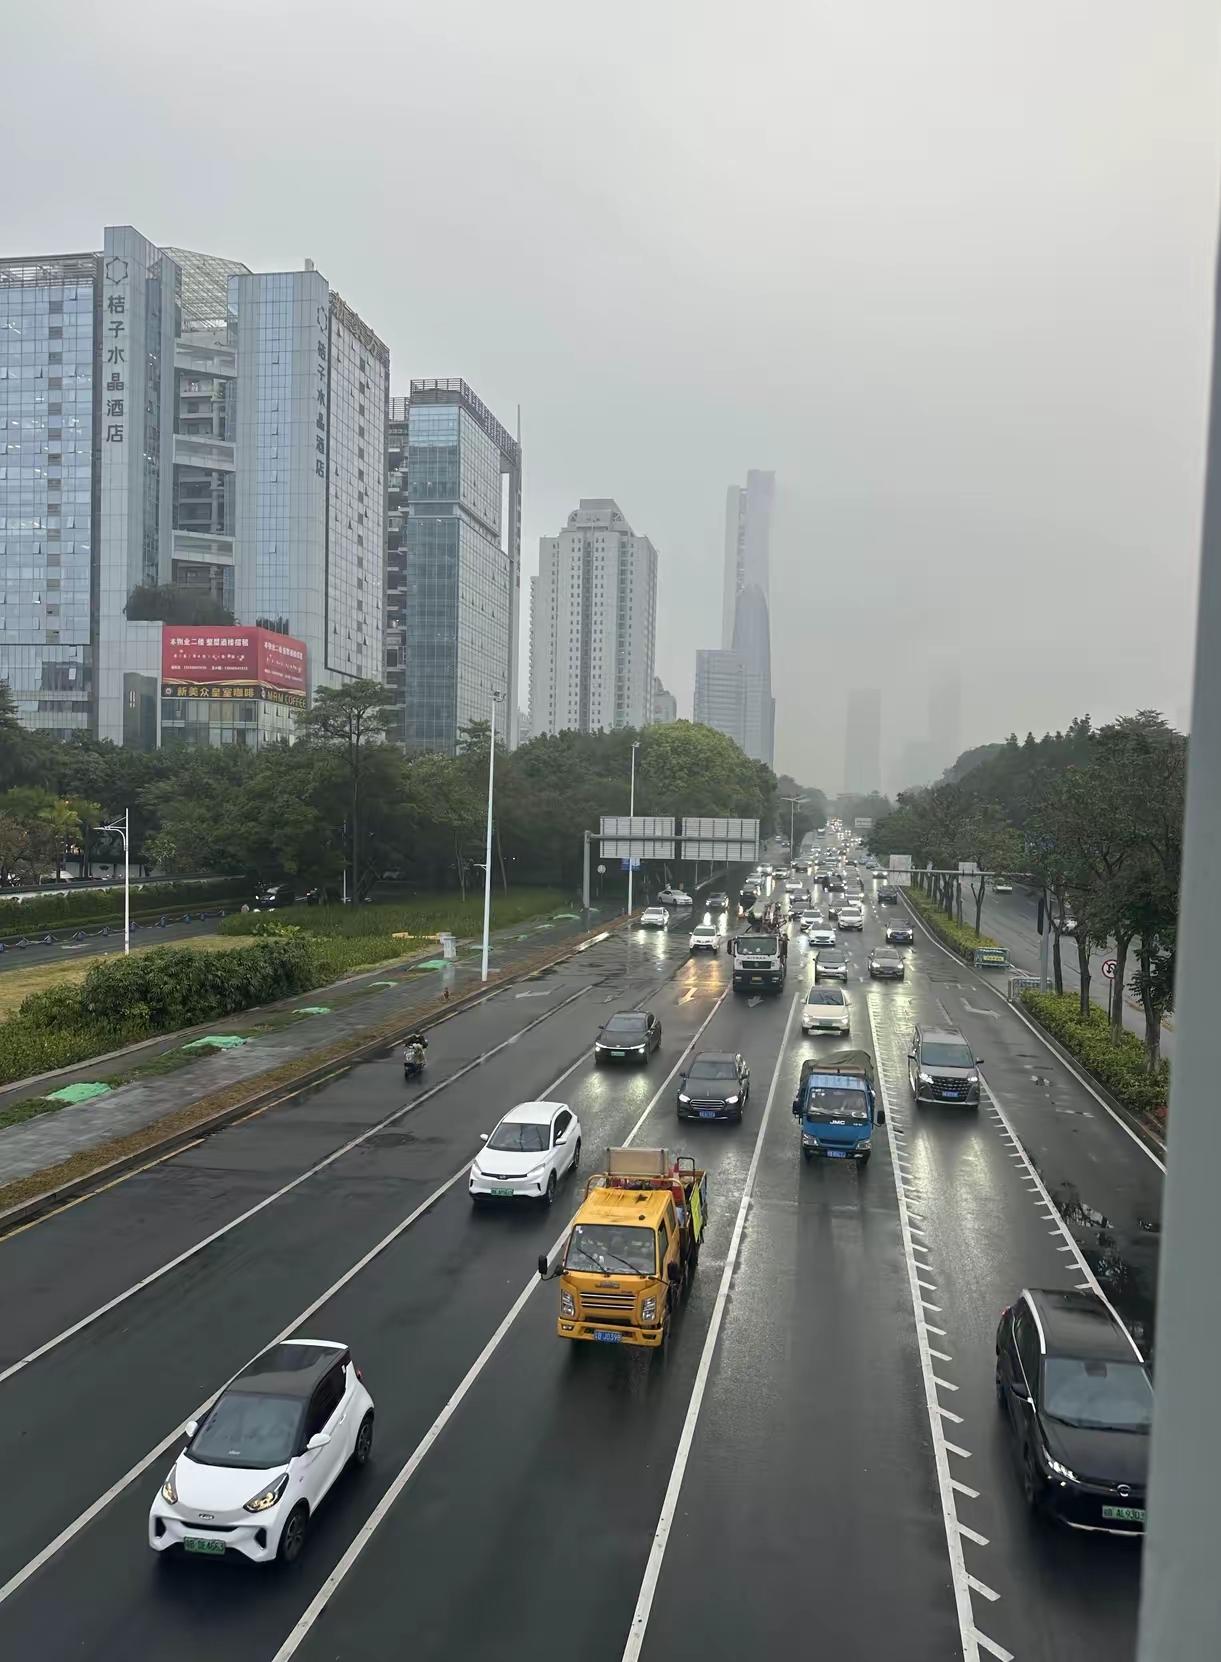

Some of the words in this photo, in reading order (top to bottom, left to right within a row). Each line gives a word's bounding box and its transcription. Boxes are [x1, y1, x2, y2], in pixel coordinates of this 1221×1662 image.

[106, 295, 125, 443] 桔子水晶酒店
[315, 340, 327, 478] 桔子水晶酒店
[285, 694, 306, 708] COFFEE
